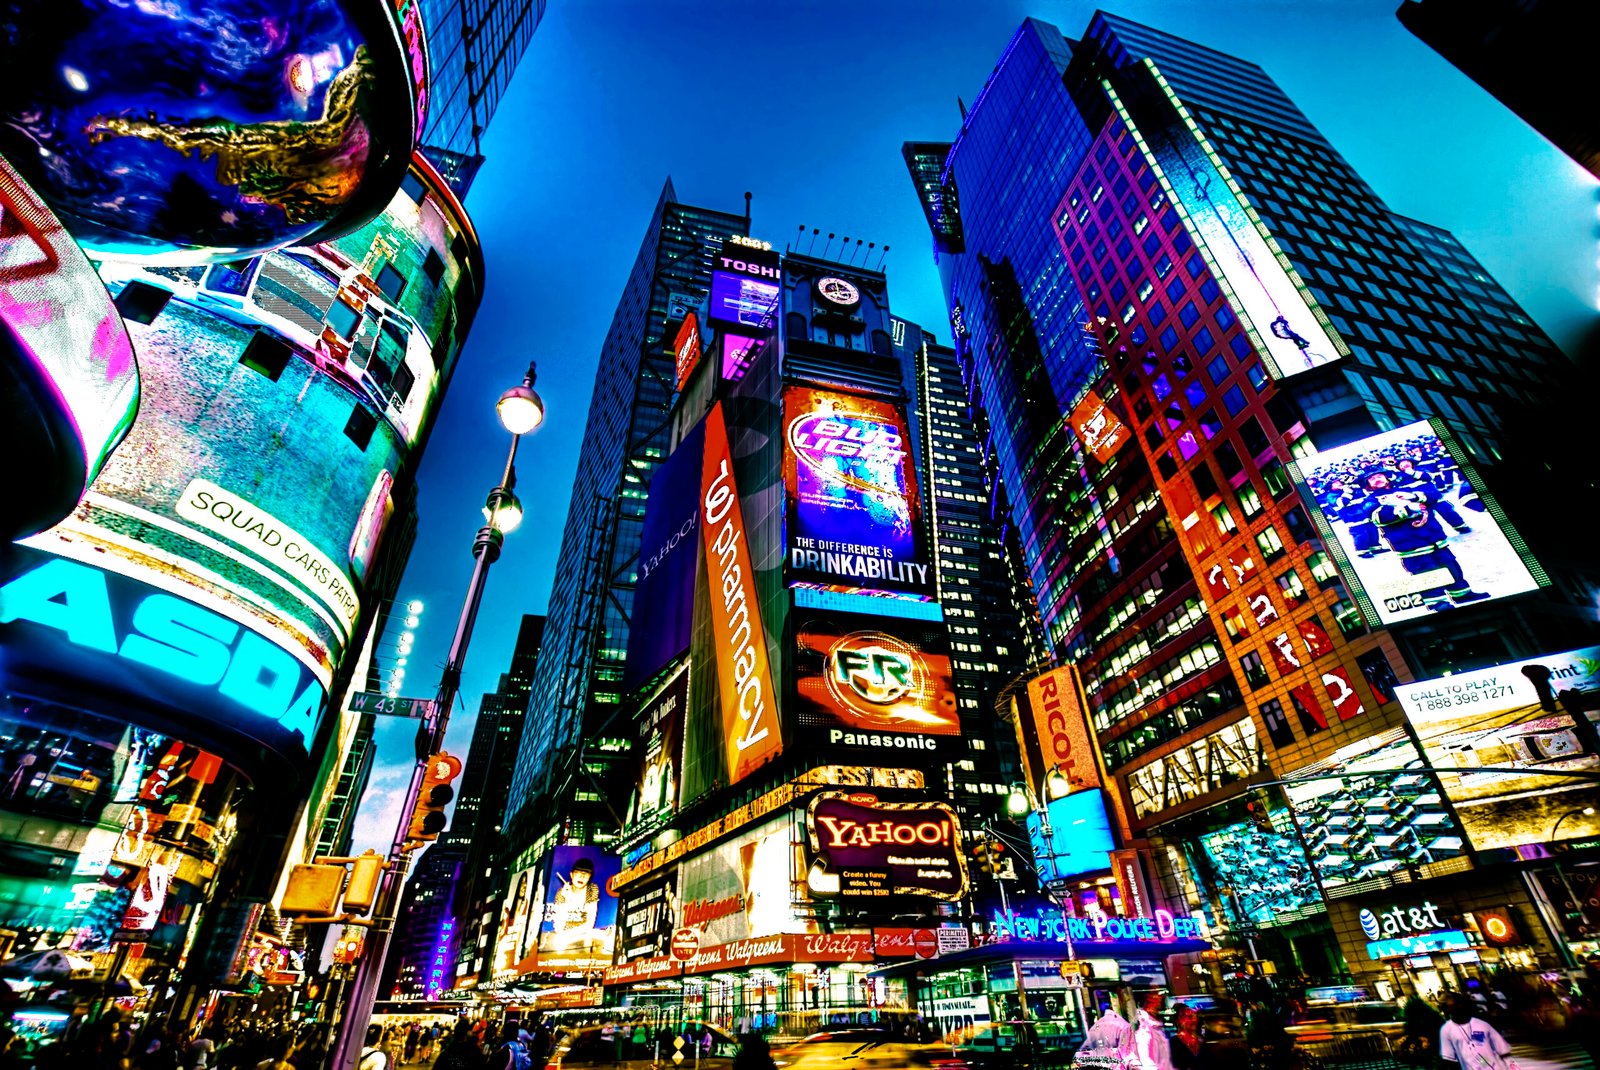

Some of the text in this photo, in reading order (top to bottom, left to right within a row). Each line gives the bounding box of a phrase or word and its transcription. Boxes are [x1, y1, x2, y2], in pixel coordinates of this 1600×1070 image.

[730, 234, 771, 251] 2009
[812, 419, 902, 448] BUD
[190, 491, 282, 548] SQUAD
[283, 540, 330, 584] CARS
[642, 510, 697, 580] YAHOO!
[796, 537, 893, 558] THE DIFFERENCE IS
[791, 547, 928, 585] DRINKABILITY
[1387, 593, 1423, 611] 002
[711, 519, 770, 752] pharmacy
[1549, 664, 1581, 680] rint
[353, 694, 414, 713] W 43 ST
[1410, 677, 1497, 701] CALL TO PLAY
[1416, 685, 1514, 712] 1 888 398 1271
[830, 729, 937, 751] Panasonic
[1039, 675, 1080, 785] RICOH
[817, 817, 950, 848] YAHOO!
[843, 870, 864, 878] Create
[869, 870, 887, 879] funny
[869, 880, 881, 888] You
[843, 888, 860, 896] could
[683, 892, 745, 933] Walgreens
[994, 908, 1040, 940] NEW
[1094, 908, 1153, 942] POLICE
[1381, 901, 1446, 935] at&t
[605, 964, 635, 984] Walgreens
[636, 957, 672, 979] Walgreens
[677, 949, 722, 974] greens
[725, 936, 786, 965] Walgreens
[804, 931, 915, 960] Walgreens
